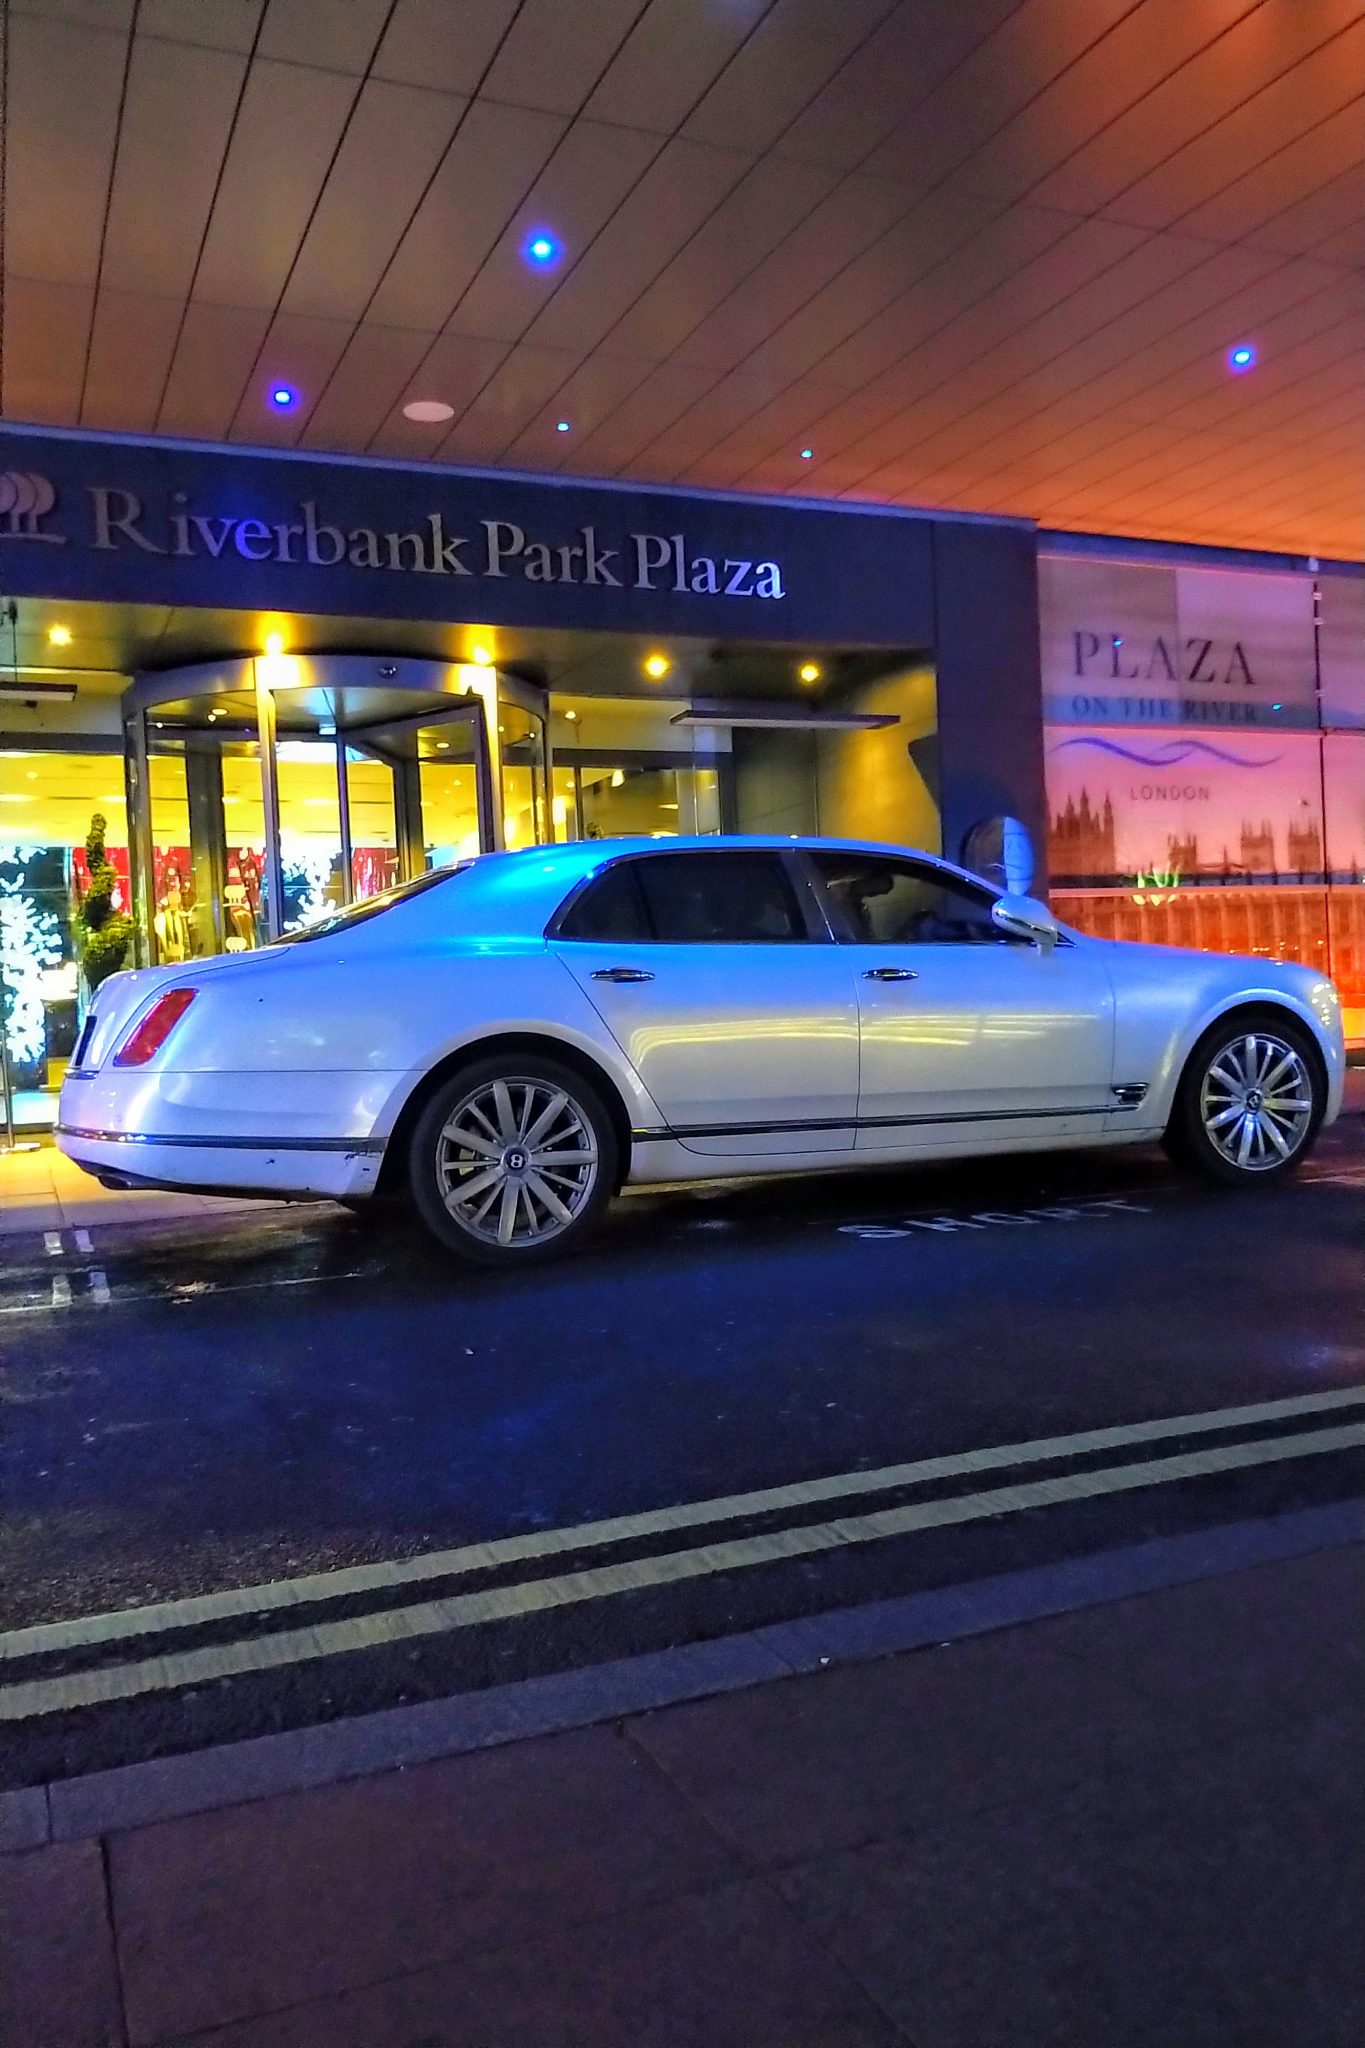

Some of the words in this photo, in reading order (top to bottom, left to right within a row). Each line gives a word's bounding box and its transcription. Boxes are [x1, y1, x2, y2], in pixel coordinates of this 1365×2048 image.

[87, 486, 474, 577] Riverbank
[480, 519, 622, 588] Park
[631, 533, 787, 600] Plaza
[1074, 631, 1255, 685] PLAZA
[1072, 695, 1108, 718] ON
[1119, 697, 1170, 718] THE
[1184, 700, 1256, 723] RIVER
[1130, 786, 1210, 801] LONDON
